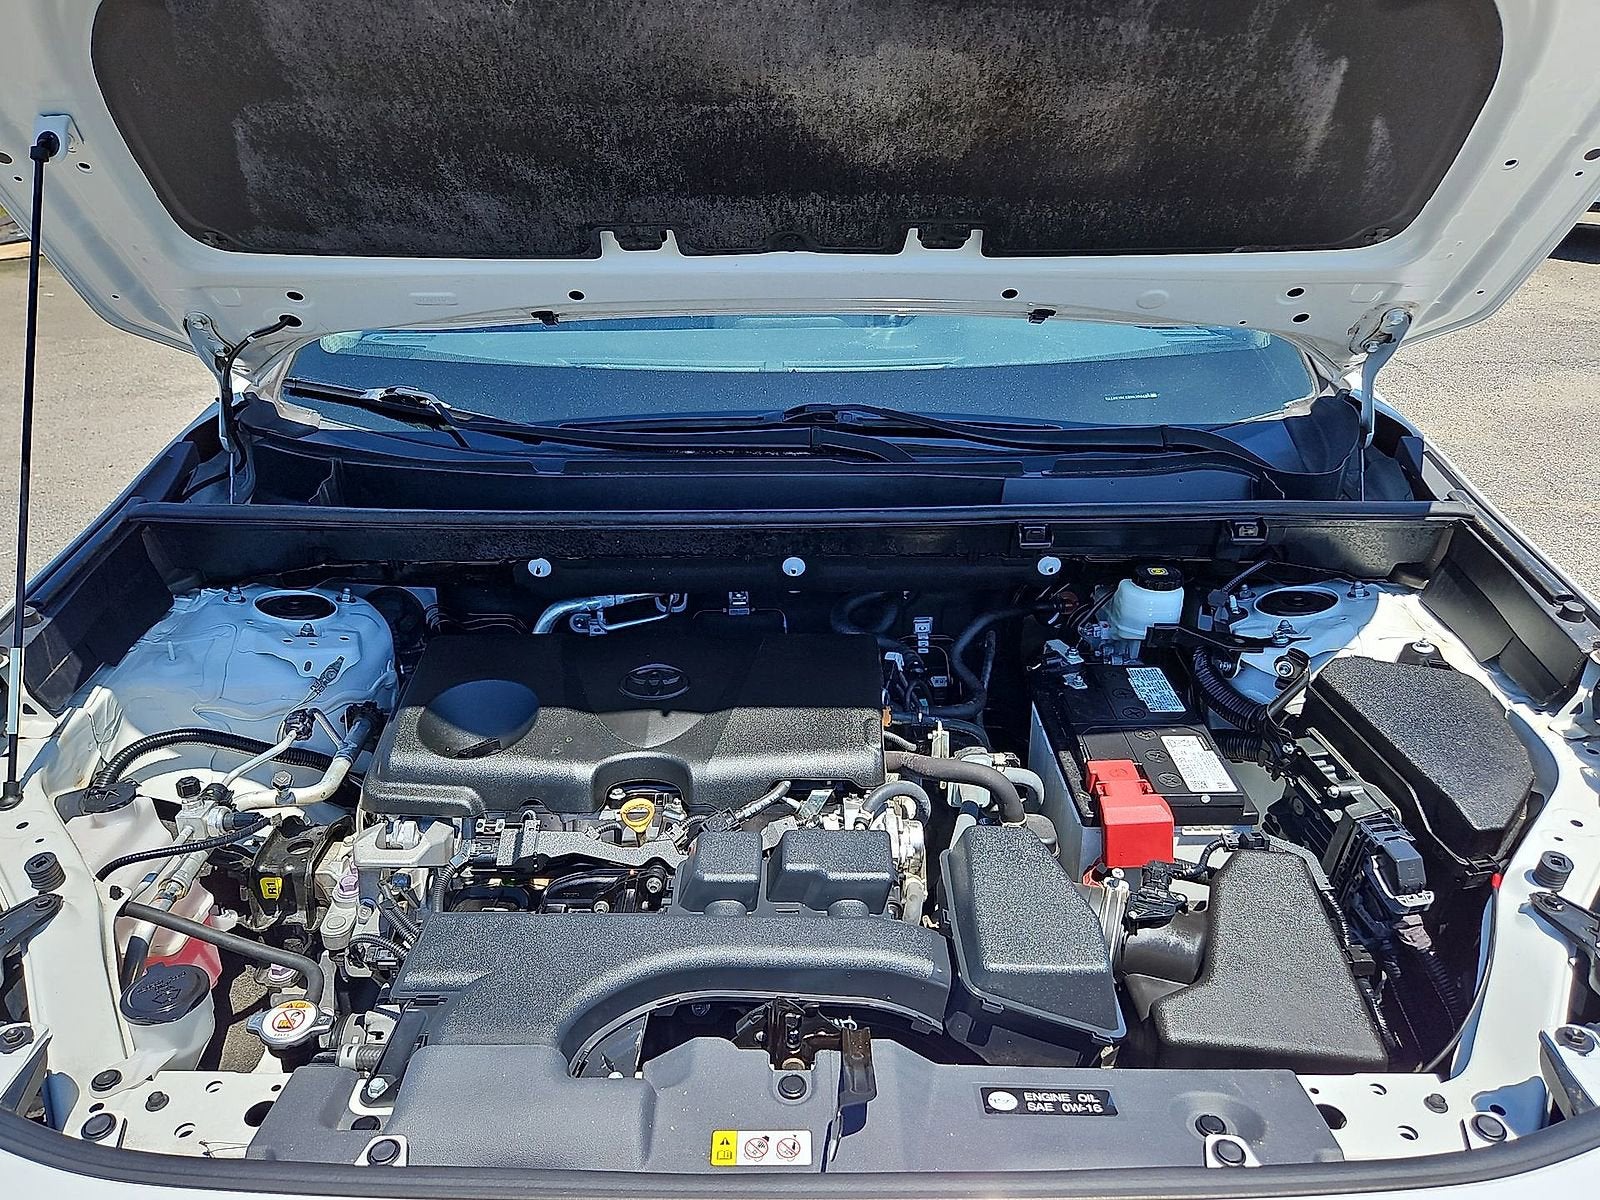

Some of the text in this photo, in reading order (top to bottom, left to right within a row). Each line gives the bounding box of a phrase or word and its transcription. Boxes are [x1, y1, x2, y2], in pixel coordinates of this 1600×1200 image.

[1023, 1091, 1071, 1103] ENGINE
[1077, 1093, 1100, 1103] OIL
[1026, 1102, 1103, 1113] SAE 0W-16
